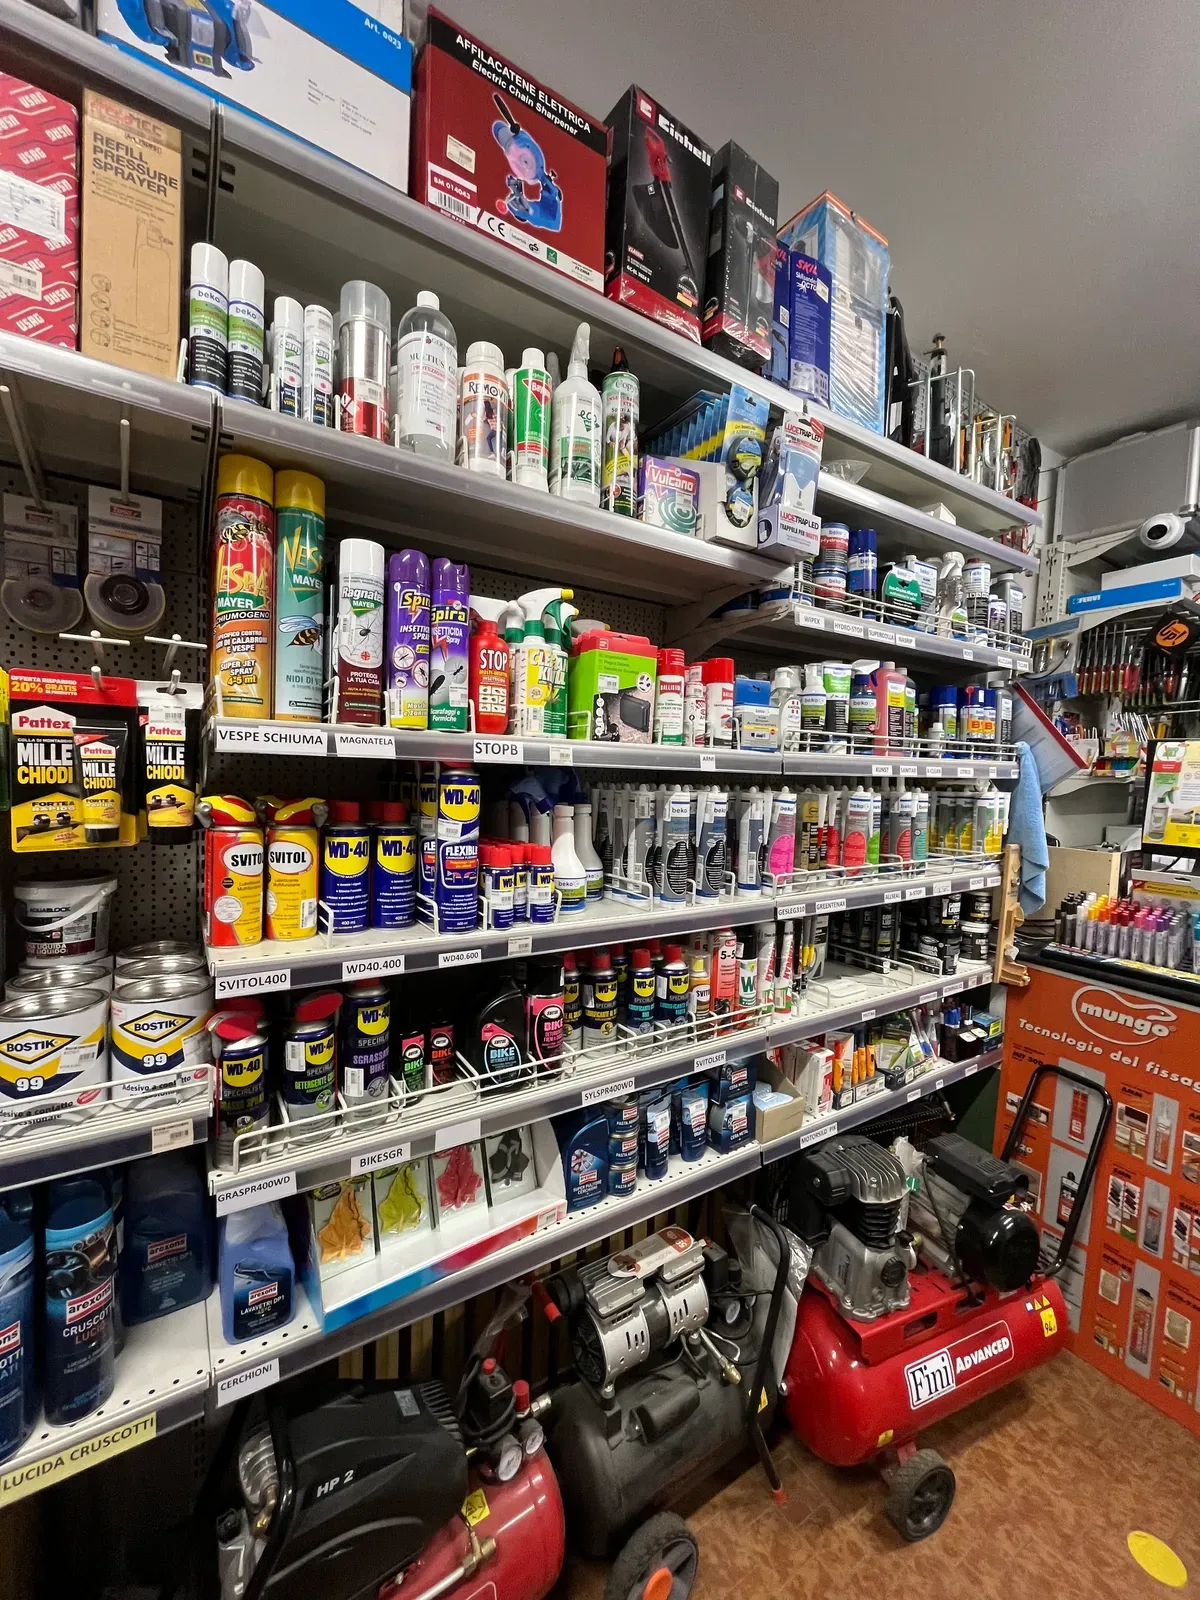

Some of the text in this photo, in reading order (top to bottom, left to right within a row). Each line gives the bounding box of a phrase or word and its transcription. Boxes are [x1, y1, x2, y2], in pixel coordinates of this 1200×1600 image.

[364, 18, 380, 35] Art.
[456, 34, 591, 134] AFFILACATENE ELETTRICA
[17, 91, 48, 109] USAG
[472, 59, 579, 136] Electric Chain Sharpener
[657, 112, 712, 168] Einhell
[92, 131, 148, 165] REFILL
[17, 147, 47, 165] USAG
[92, 146, 178, 190] PRESSURE
[92, 158, 168, 198] SPRAYER
[745, 196, 776, 228] Einhell
[796, 259, 818, 276] SKIL
[198, 290, 221, 303] beko
[235, 306, 257, 319] beko
[16, 312, 45, 332] USAG
[651, 467, 694, 491] Vulcano
[293, 573, 323, 588] MAYER
[217, 597, 254, 609] MAYER
[352, 599, 376, 610] MAYER
[431, 606, 467, 624] Spira
[834, 622, 863, 634] HYDRO-STOP
[232, 644, 256, 653] VESPE
[446, 636, 461, 646] Spray
[220, 659, 256, 671] SUPER JET
[480, 648, 508, 672] STOP
[230, 667, 254, 676] SPRAY
[286, 674, 304, 683] NIDI
[350, 671, 378, 680] PROTEGGI
[10, 675, 77, 686] OFFERTA RISPARMIO
[227, 675, 243, 686] 4-5
[355, 676, 368, 684] TUA
[11, 682, 77, 694] 20% GRATIS
[804, 696, 819, 704] beko
[19, 715, 71, 729] Pattex
[432, 714, 458, 724] Formiche
[149, 725, 182, 736] Pattex
[218, 729, 324, 746] VESPE SCHIUMA
[339, 735, 394, 747] MAGNATELA
[474, 741, 519, 756] STOPB
[17, 742, 73, 766] MILLE
[83, 747, 113, 755] Pattex
[146, 746, 185, 766] MILLE
[17, 766, 73, 785] CHIODI
[82, 762, 116, 778] MILLE
[146, 765, 185, 780] CHIODI
[83, 777, 116, 789] CHIODI
[444, 788, 480, 805] WD-40
[328, 840, 369, 859] WD-40
[269, 851, 307, 864] SVITOL
[816, 900, 846, 911] GREENTENAX
[443, 950, 480, 963] WD40.600
[346, 958, 402, 975] WD40.400
[218, 972, 288, 993] SVITOL400
[134, 1019, 178, 1032] BOSTIK
[544, 1018, 564, 1032] BIKE
[1080, 1001, 1170, 1038] mungo
[6, 1037, 56, 1052] BOSTIK
[143, 1053, 168, 1068] 99
[431, 1048, 452, 1060] BIKE
[490, 1047, 515, 1059] BIKE
[695, 1053, 725, 1068] SVITOLSER
[1110, 1050, 1139, 1068] del
[226, 1059, 260, 1077] WD-40
[369, 1061, 385, 1075] BIKE
[404, 1058, 424, 1072] BIKE
[16, 1076, 44, 1092] 99
[122, 1083, 150, 1093] Adesivo
[584, 1080, 634, 1101] SYLSPR400WD
[359, 1147, 404, 1168] BIKESGR
[217, 1174, 291, 1204] GRASPR400WD
[149, 1238, 186, 1256] arexons
[68, 1284, 112, 1316] arexons
[249, 1285, 277, 1300] arexons
[240, 1299, 272, 1316] LAVAVETRI
[955, 1337, 1010, 1374] ADVANCED
[220, 1363, 273, 1391] CERCHIONI
[909, 1355, 953, 1403] Fini
[3, 1416, 155, 1492] LUCIDA CRUSCOTTI
[316, 1469, 355, 1498] HP 2
